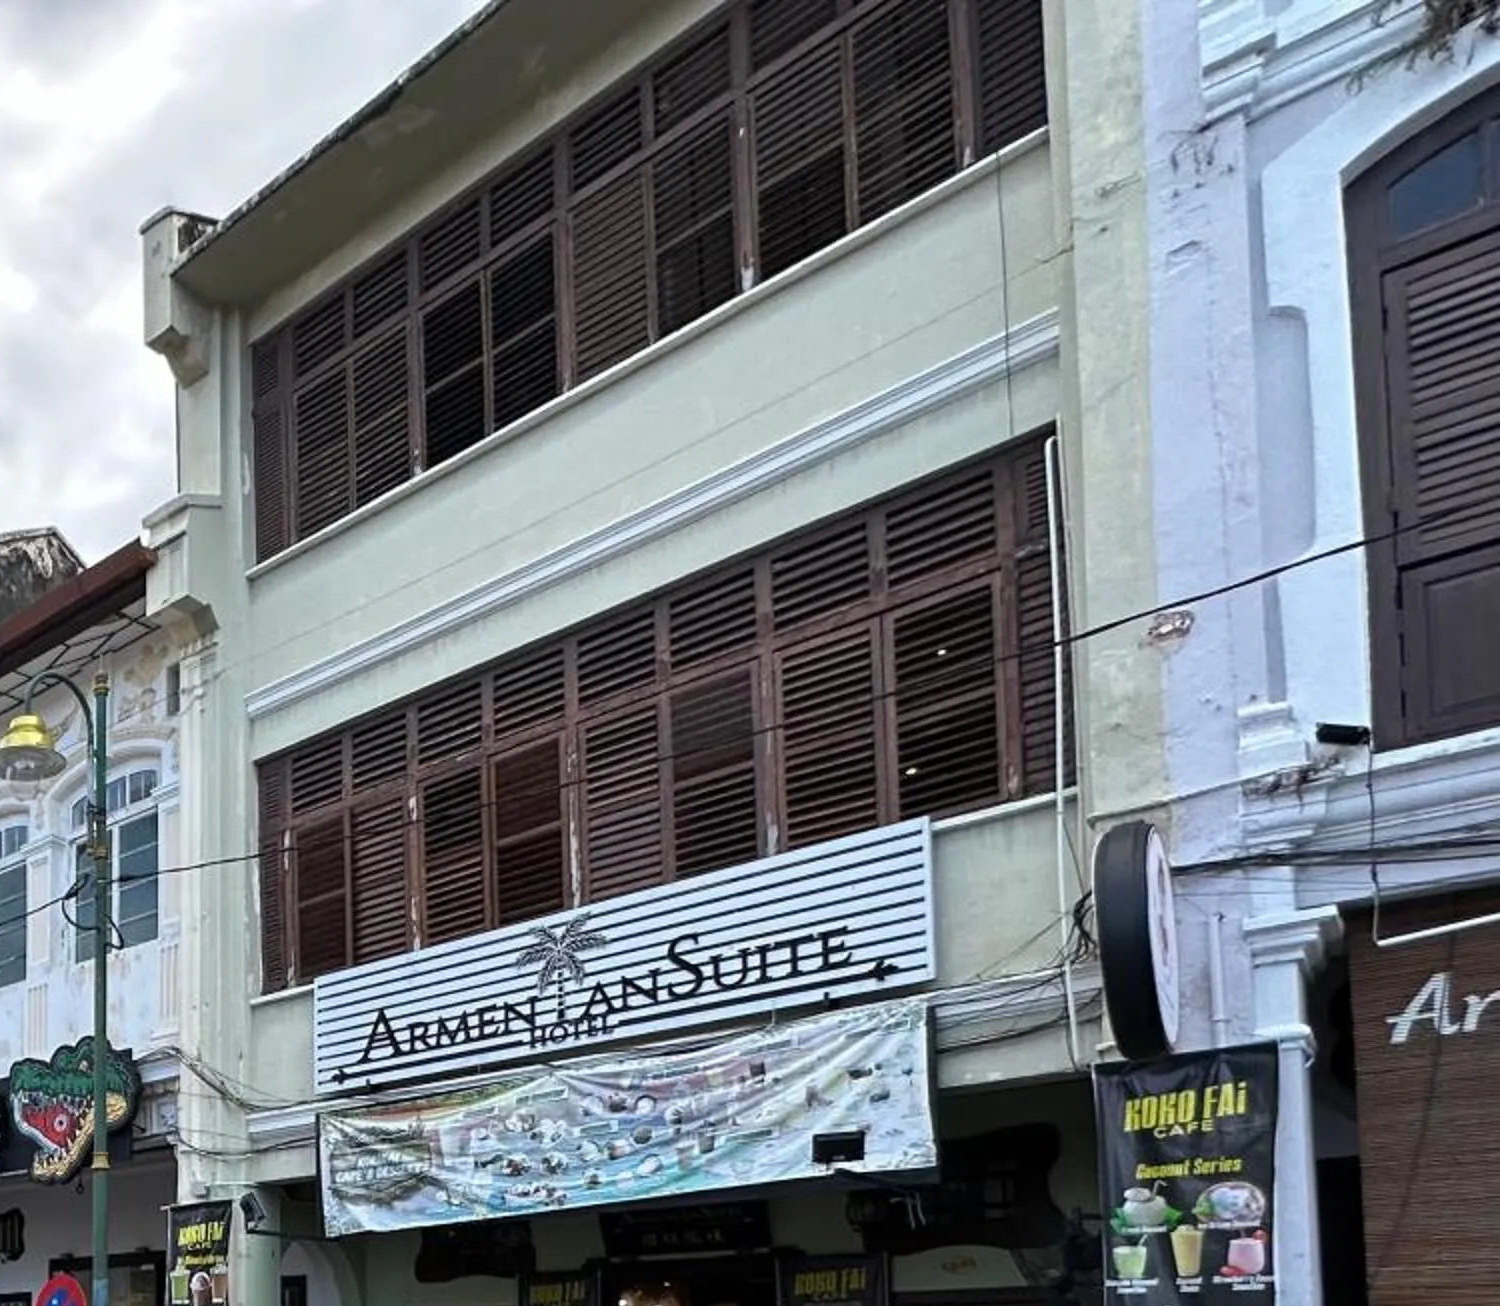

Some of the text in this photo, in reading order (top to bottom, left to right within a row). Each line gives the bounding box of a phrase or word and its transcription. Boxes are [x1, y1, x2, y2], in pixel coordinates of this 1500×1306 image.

[528, 1014, 615, 1049] HOTEL
[1123, 1089, 1197, 1133] KOKO
[1153, 1118, 1215, 1139] CAFE
[1193, 1155, 1243, 1175] Series
